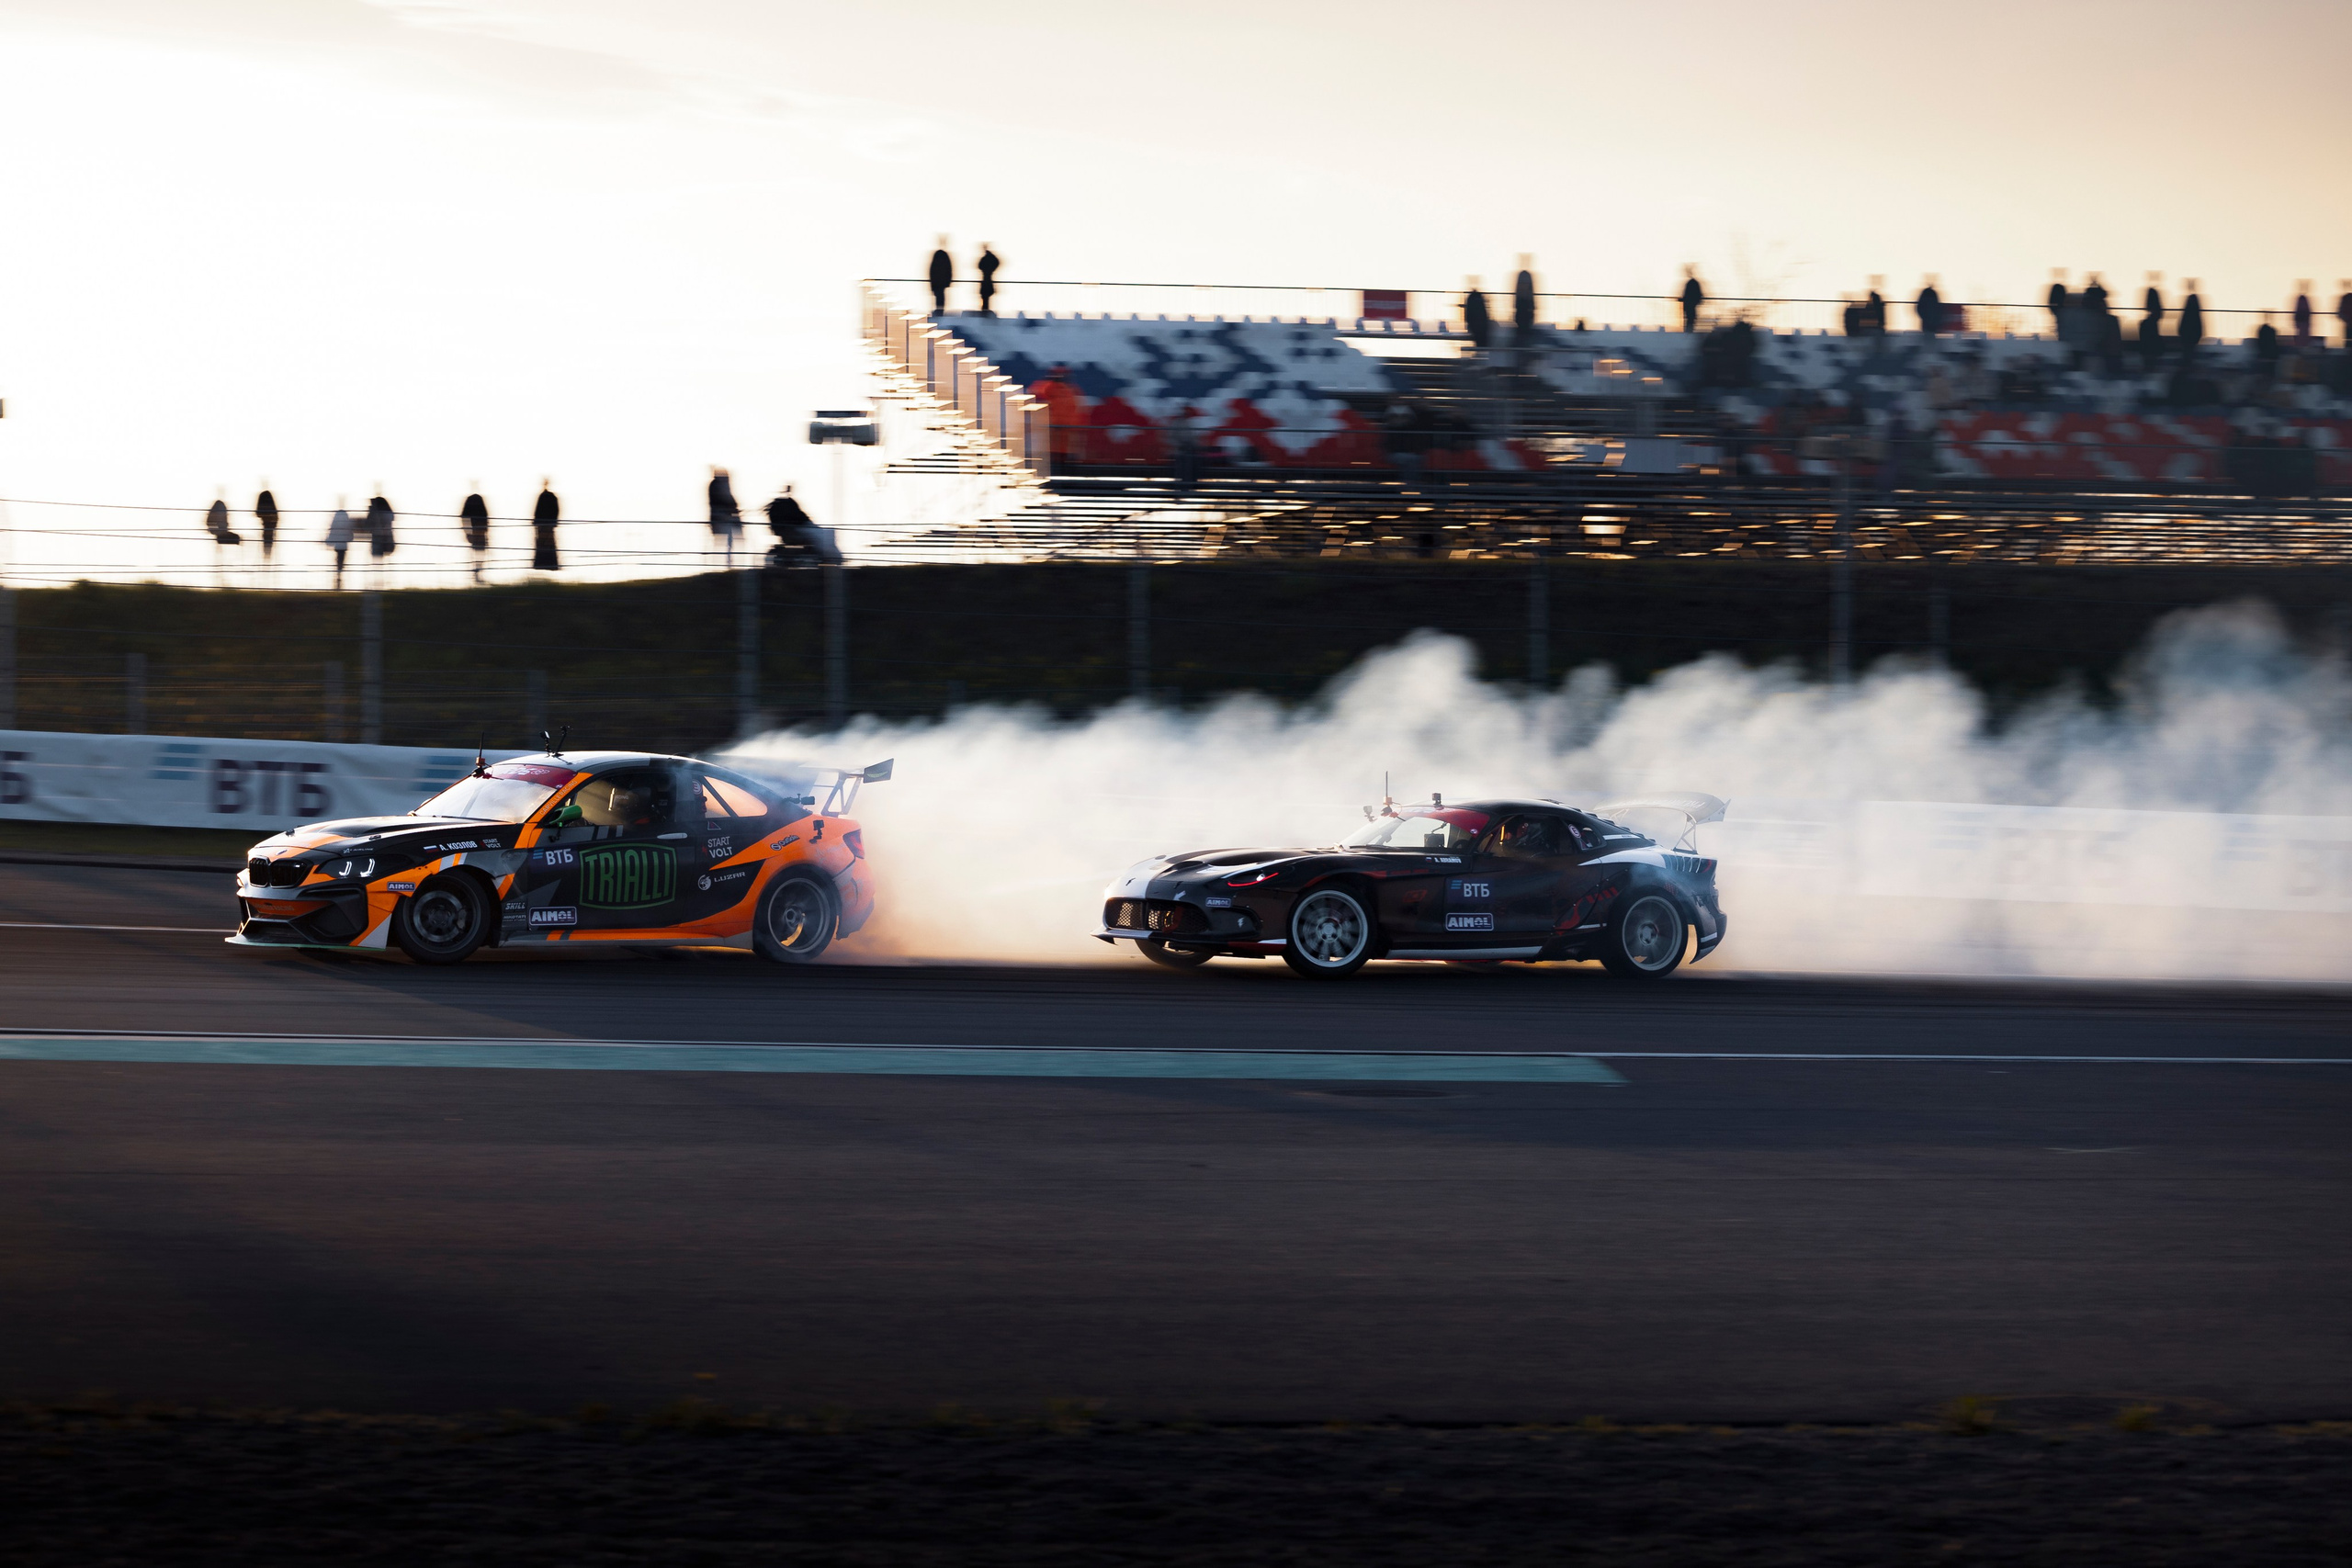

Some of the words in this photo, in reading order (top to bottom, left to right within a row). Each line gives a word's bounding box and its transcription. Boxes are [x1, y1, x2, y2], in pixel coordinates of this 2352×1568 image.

[209, 759, 333, 818] ВТБ
[447, 840, 478, 851] КОЗЛОВ
[707, 836, 730, 848] START
[545, 849, 573, 865] ВТБ
[708, 846, 733, 859] VOLT
[584, 849, 670, 903] TRIALLI
[714, 871, 746, 883] LUZAR
[1463, 883, 1490, 897] ВТБ
[505, 902, 526, 910] SKILL
[531, 910, 575, 922] AIMOL
[1448, 917, 1491, 928] AIMOL
